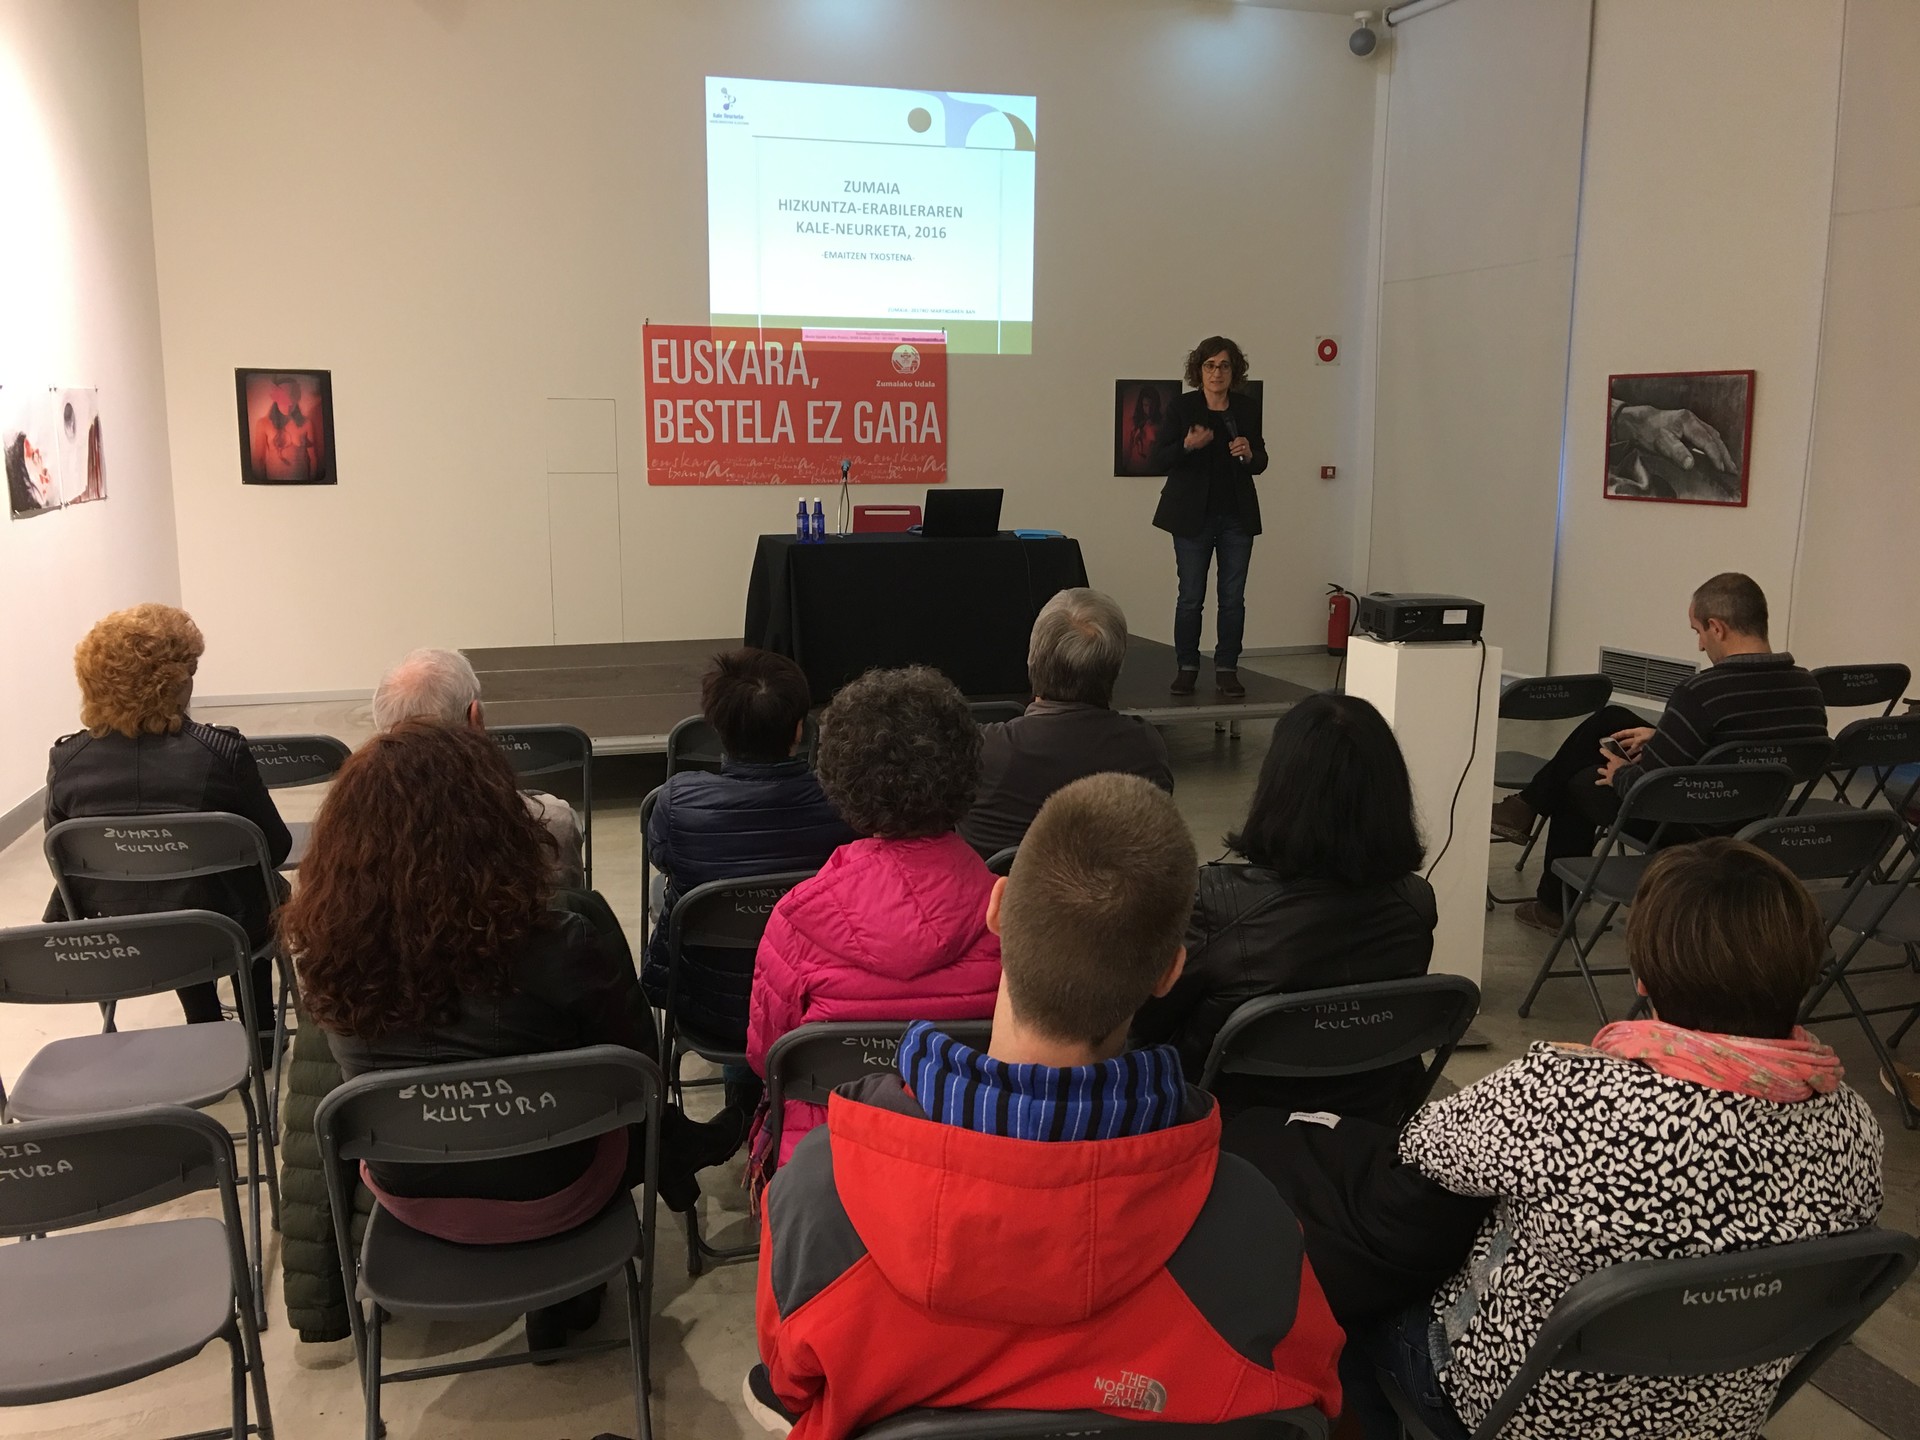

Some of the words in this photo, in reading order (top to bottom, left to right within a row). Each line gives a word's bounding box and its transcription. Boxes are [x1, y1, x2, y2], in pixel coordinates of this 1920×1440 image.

[843, 180, 901, 195] ZUMAIA
[778, 199, 964, 218] HIZKUNTZA-ERABILERAREN
[796, 221, 912, 240] KALE-NEURKETA,
[914, 226, 947, 239] 2016
[650, 338, 820, 389] EUSKARA,
[876, 380, 912, 388] Zumaiako
[914, 380, 935, 388] Udala
[653, 399, 796, 444] BESTELA
[807, 400, 843, 444] EZ
[854, 400, 942, 444] GARA
[497, 743, 531, 751] TURA
[1686, 789, 1739, 800] KULTURA
[115, 841, 189, 852] KULTURA
[1781, 834, 1832, 846] KULTURA
[54, 946, 140, 961] KULTURA
[1314, 1010, 1394, 1030] KULTURA
[422, 1091, 557, 1122] KULTURA
[0, 1160, 74, 1181] TURA
[1682, 1279, 1783, 1305] KULTURA
[1094, 1376, 1145, 1400] NORTH
[1120, 1370, 1149, 1388] THE
[1102, 1392, 1139, 1409] FACE
